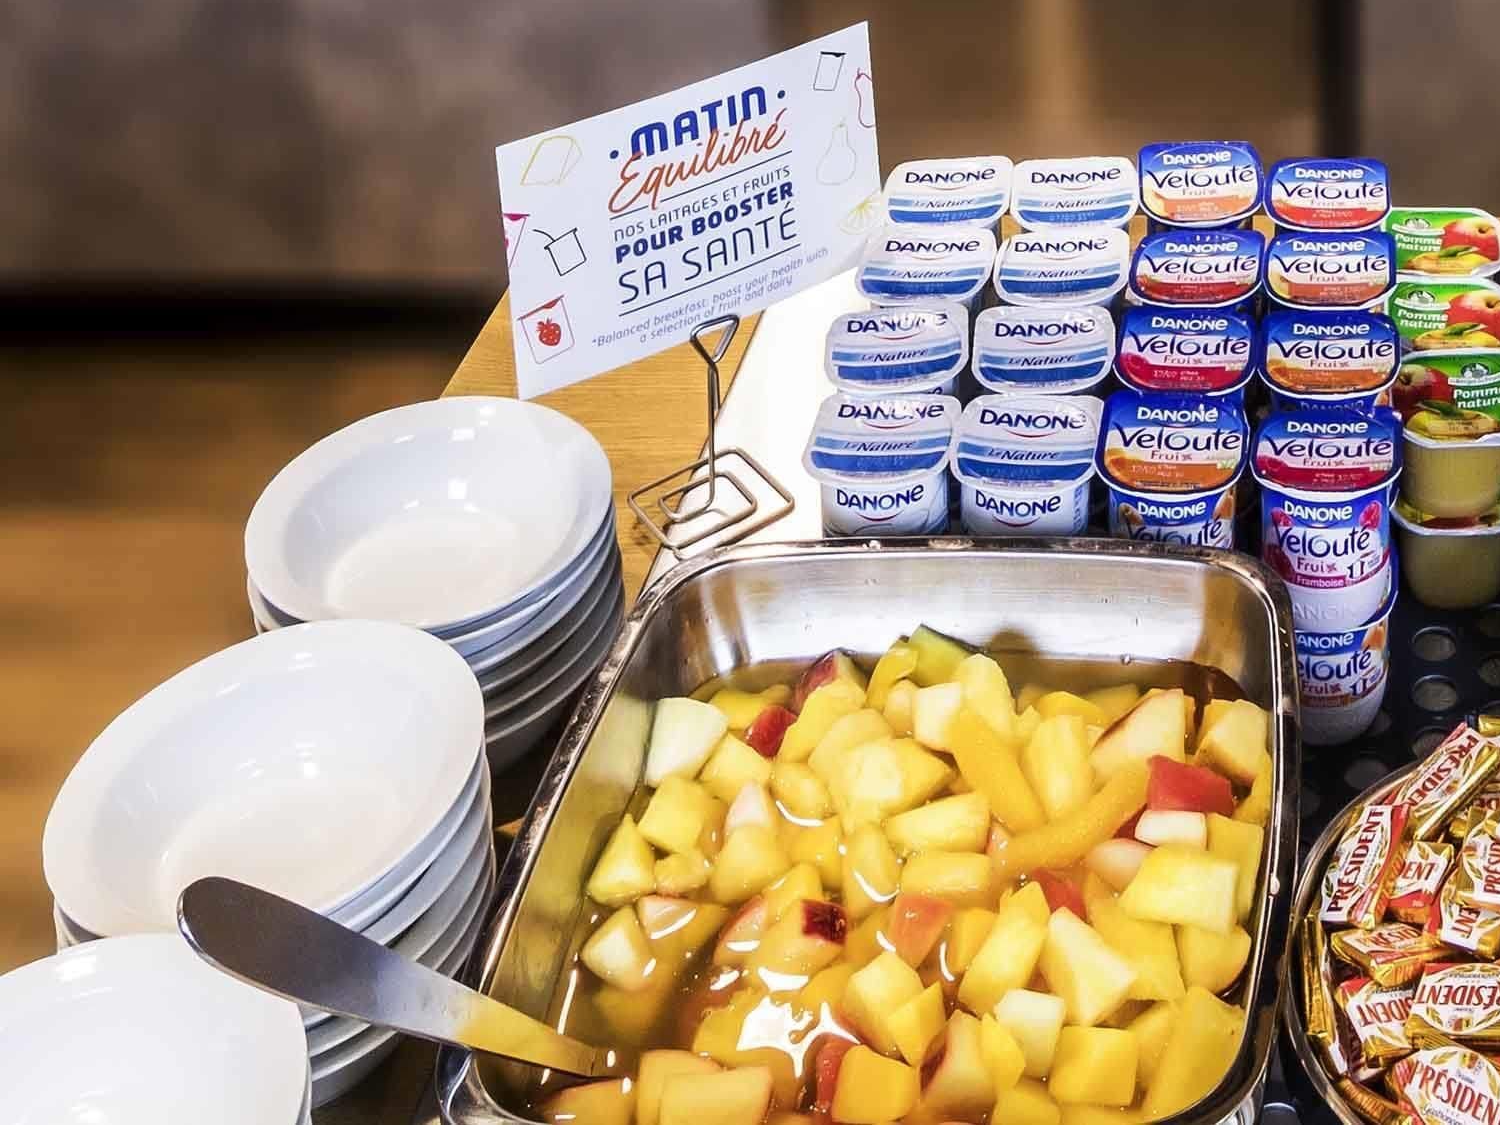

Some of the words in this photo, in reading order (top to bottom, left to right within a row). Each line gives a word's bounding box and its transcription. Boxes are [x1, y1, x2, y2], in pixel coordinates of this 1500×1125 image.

[631, 86, 767, 161] MATIN
[614, 223, 645, 243] NOS
[650, 193, 718, 230] LAITAGES
[723, 186, 739, 206] ET
[743, 165, 792, 197] FRUITS
[615, 225, 685, 264] POUR
[691, 181, 794, 236] BOOSTER
[618, 260, 668, 305] SA
[681, 202, 797, 281] SANTÉ
[1273, 254, 1387, 275] Velouté
[1397, 307, 1449, 323] Pomme
[1399, 318, 1447, 330] nature
[1129, 330, 1248, 356] Velouté
[1274, 337, 1393, 359] Velouté
[1115, 421, 1241, 451] Velouté
[1264, 436, 1391, 458] Velouté
[1274, 525, 1370, 559] Velouté
[1297, 575, 1345, 589] Framboise
